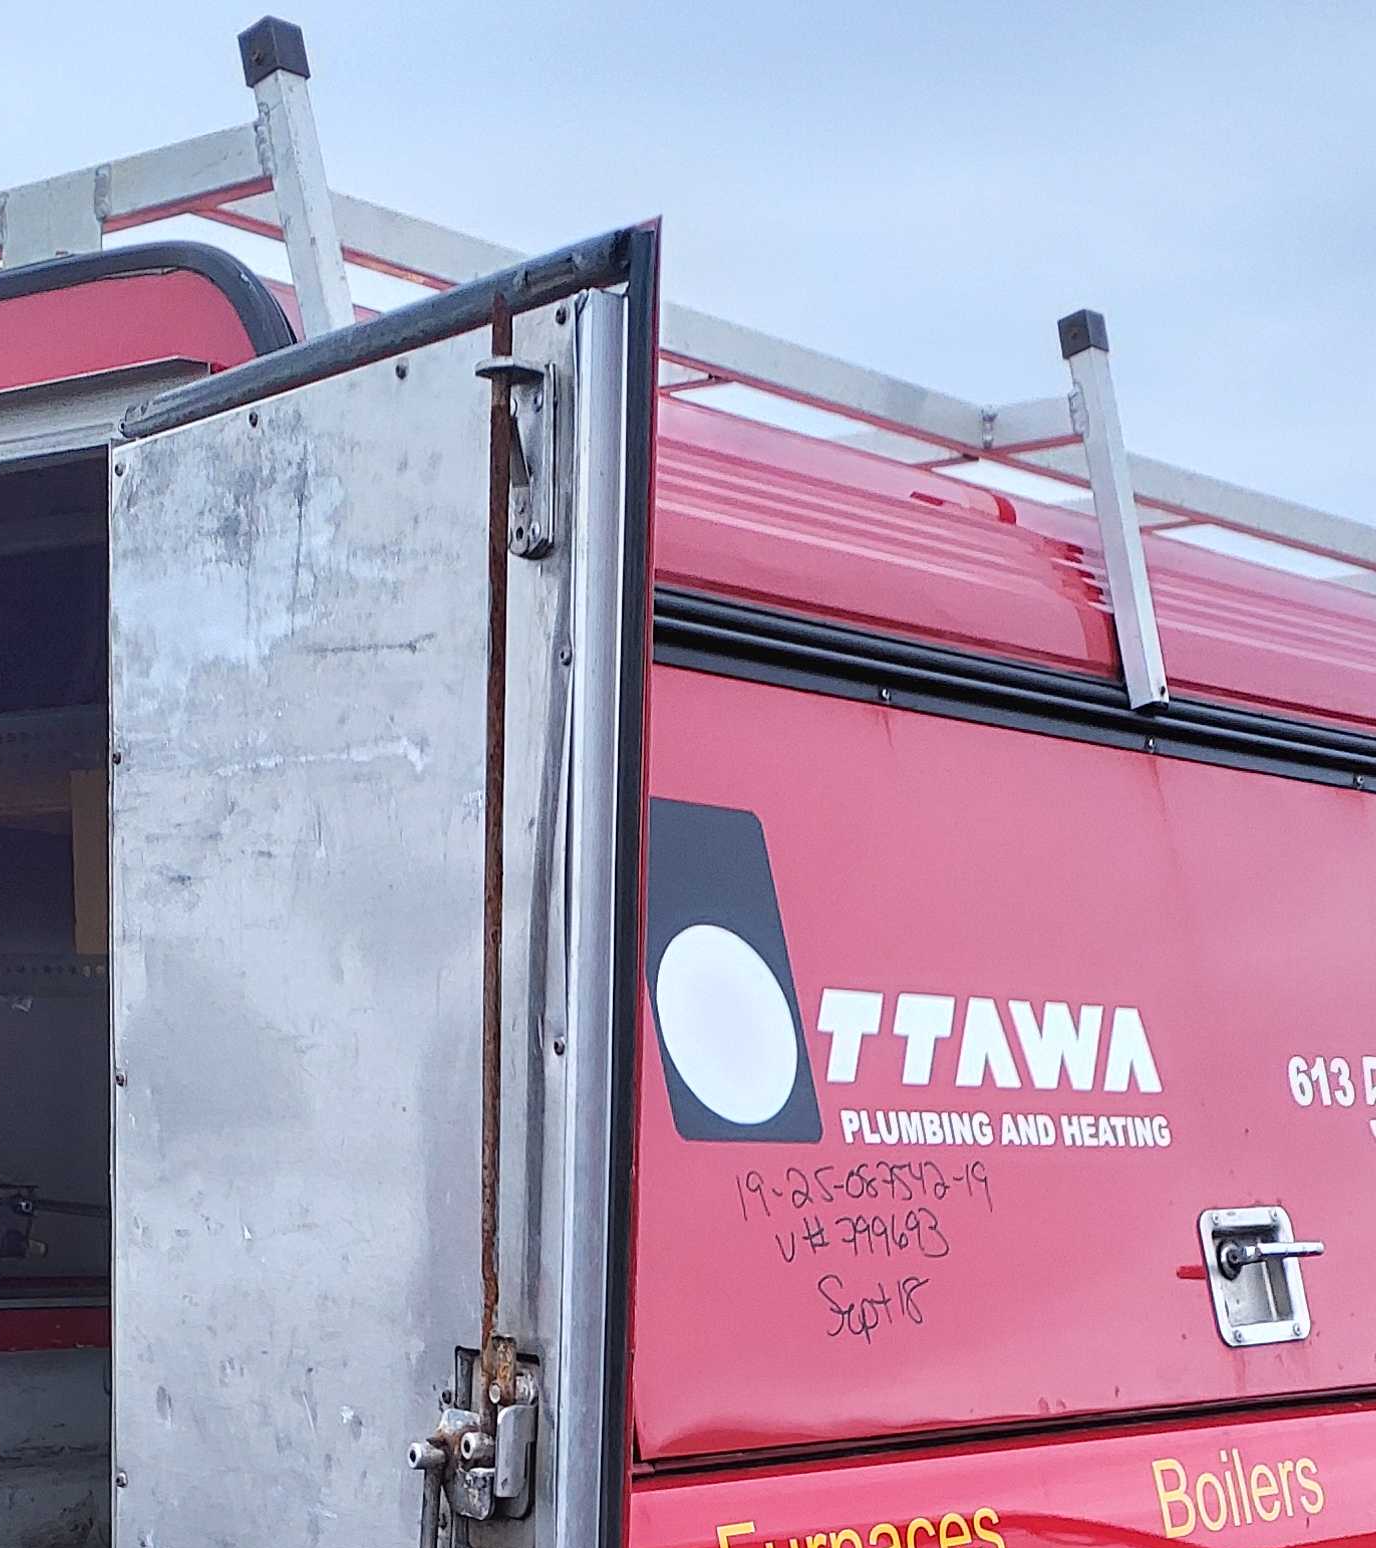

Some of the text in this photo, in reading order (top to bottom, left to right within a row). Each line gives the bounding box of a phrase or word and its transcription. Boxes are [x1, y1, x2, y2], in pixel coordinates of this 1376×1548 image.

[1287, 1055, 1356, 1107] 613
[839, 1109, 1173, 1149] PLUMBING AND HEATING
[1150, 1447, 1326, 1540] Boilers
